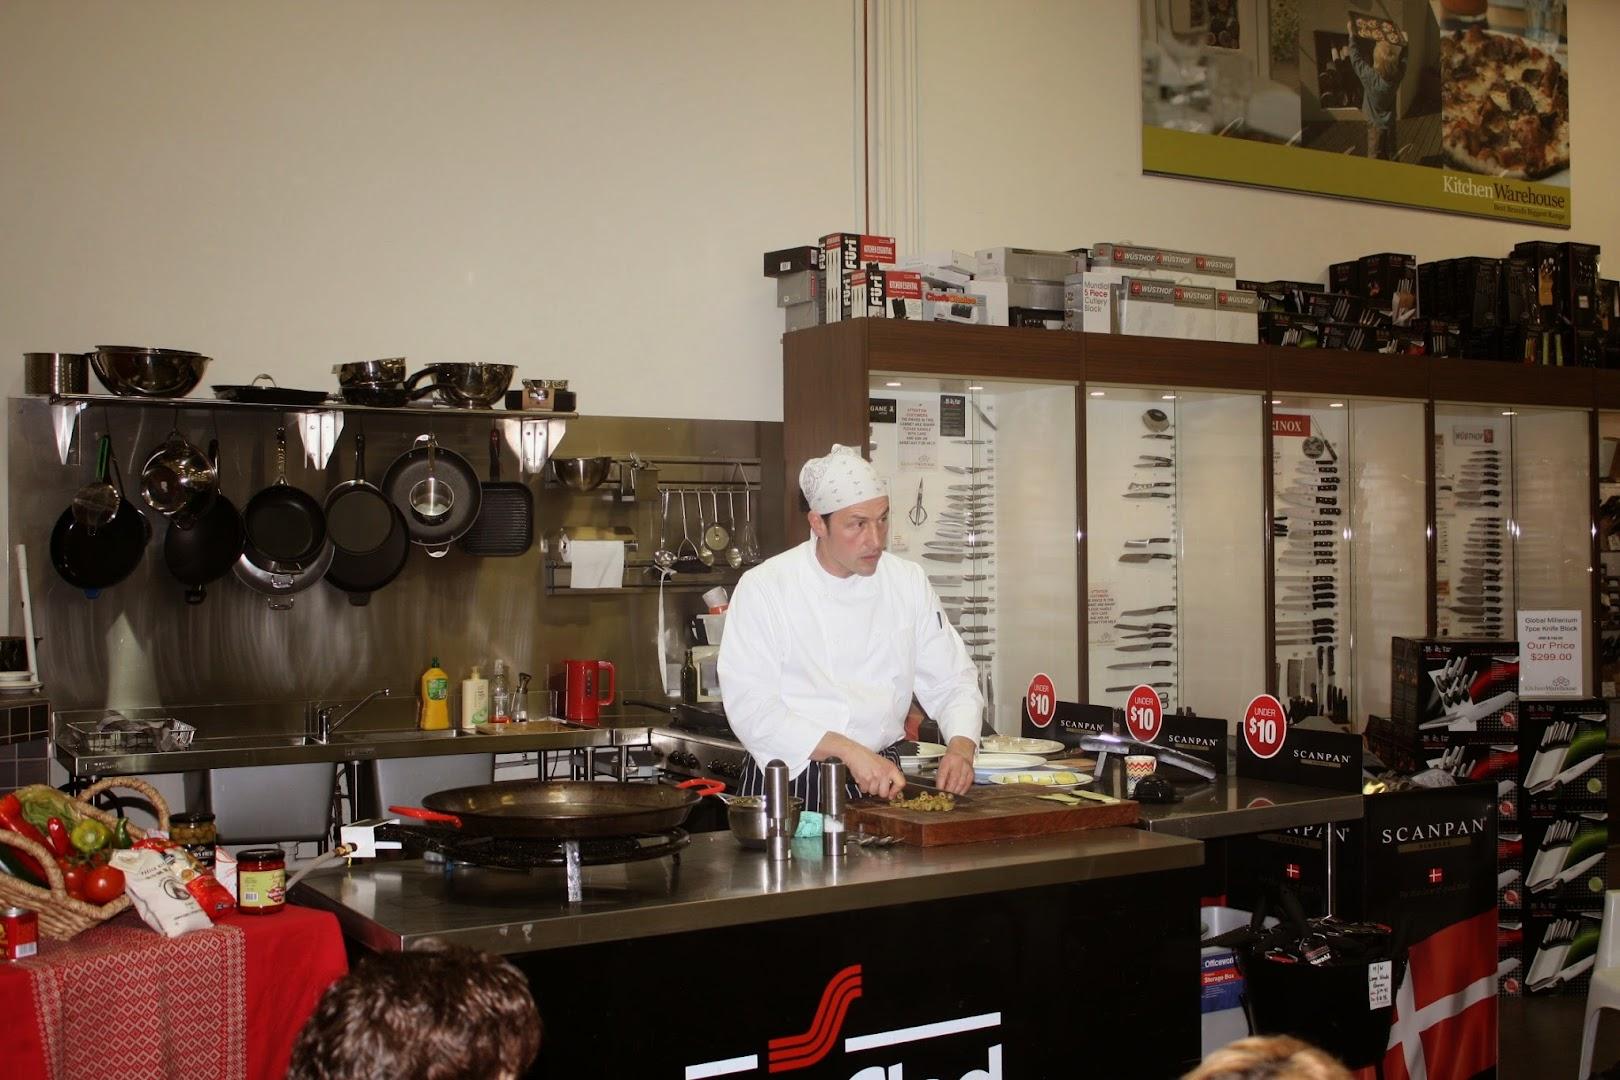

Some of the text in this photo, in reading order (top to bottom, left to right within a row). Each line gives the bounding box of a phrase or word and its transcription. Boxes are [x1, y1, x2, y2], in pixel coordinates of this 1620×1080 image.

[1124, 253, 1155, 262] WÜSTHOF
[1162, 255, 1192, 264] WÜSTHOF
[1205, 260, 1234, 269] WÜSTHOF
[1084, 280, 1110, 290] Mundial
[1141, 285, 1174, 295] WÜSTHOF
[1091, 290, 1108, 298] Piece
[1183, 291, 1213, 301] WÜSTHOF
[1084, 297, 1107, 307] Cutlery
[1228, 296, 1255, 305] WÜSTHOF
[1084, 305, 1102, 313] Block
[1527, 641, 1576, 650] Our Price
[1530, 653, 1572, 661] $299.00
[1034, 684, 1049, 693] UNDER
[1030, 692, 1049, 716] $10
[1134, 697, 1154, 705] UNDER
[1254, 707, 1276, 717] UNDER
[1130, 706, 1154, 731] $10
[1060, 719, 1103, 732] SCANPAN
[1249, 717, 1277, 745] $10
[1168, 734, 1216, 747] SCANPAN
[1293, 749, 1350, 764] SCANPAN
[1382, 817, 1485, 844] SCANPAN
[1204, 975, 1224, 984] Storage
[1225, 973, 1235, 981] Box
